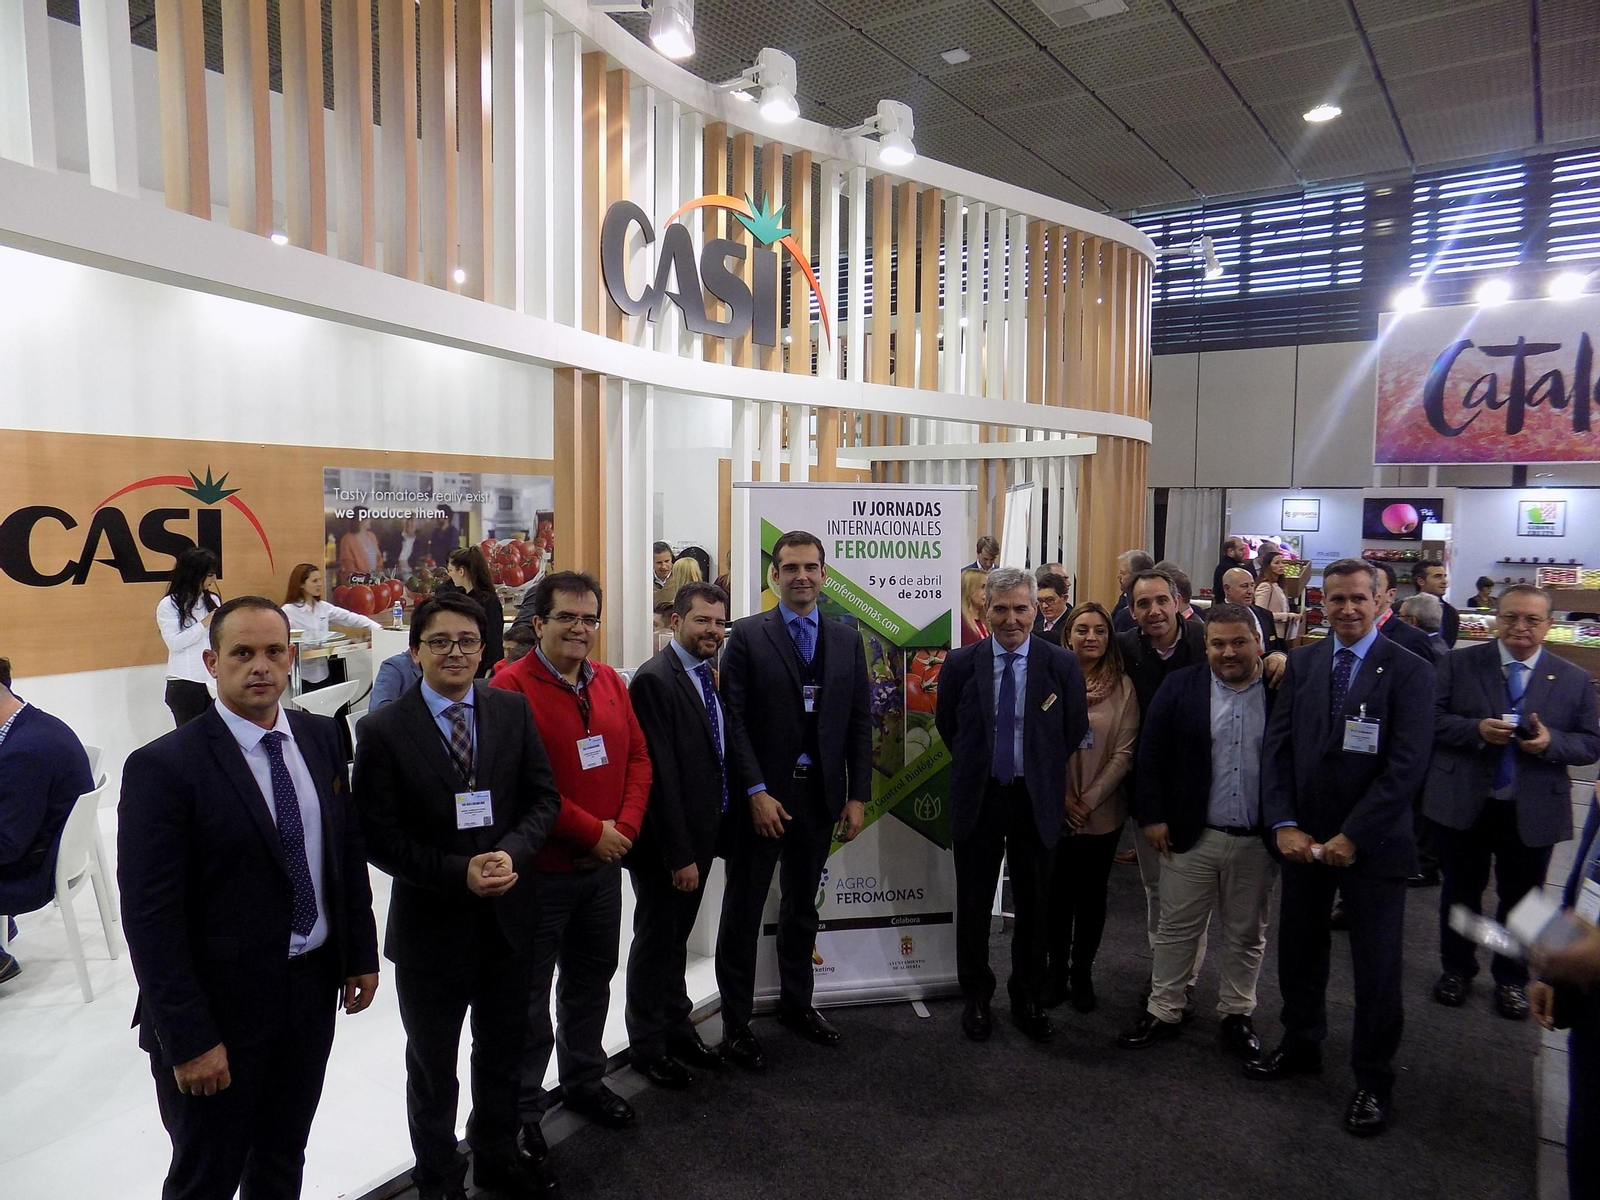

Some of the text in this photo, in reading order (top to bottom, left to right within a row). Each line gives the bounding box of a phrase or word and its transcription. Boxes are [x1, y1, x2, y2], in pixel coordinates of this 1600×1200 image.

[601, 200, 777, 347] CASI
[1424, 331, 1600, 437] CaTal
[334, 487, 367, 503] Tasty
[371, 488, 429, 502] tomatoes
[432, 490, 463, 503] really
[334, 507, 449, 521] we produce them.
[853, 501, 942, 517] IV JORNADAS
[827, 520, 942, 536] INTERNACIONALES
[0, 506, 223, 587] CASI
[835, 540, 942, 559] FEROMONAS
[869, 575, 942, 589] 5 y 6 de abril
[898, 590, 942, 599] de 2018
[823, 575, 900, 635] groferomonas.com
[874, 781, 906, 807] Control
[904, 750, 944, 781] Biológico
[836, 877, 877, 889] AGRO
[836, 888, 924, 905] FEROMONAS
[891, 917, 921, 925] Colabora
